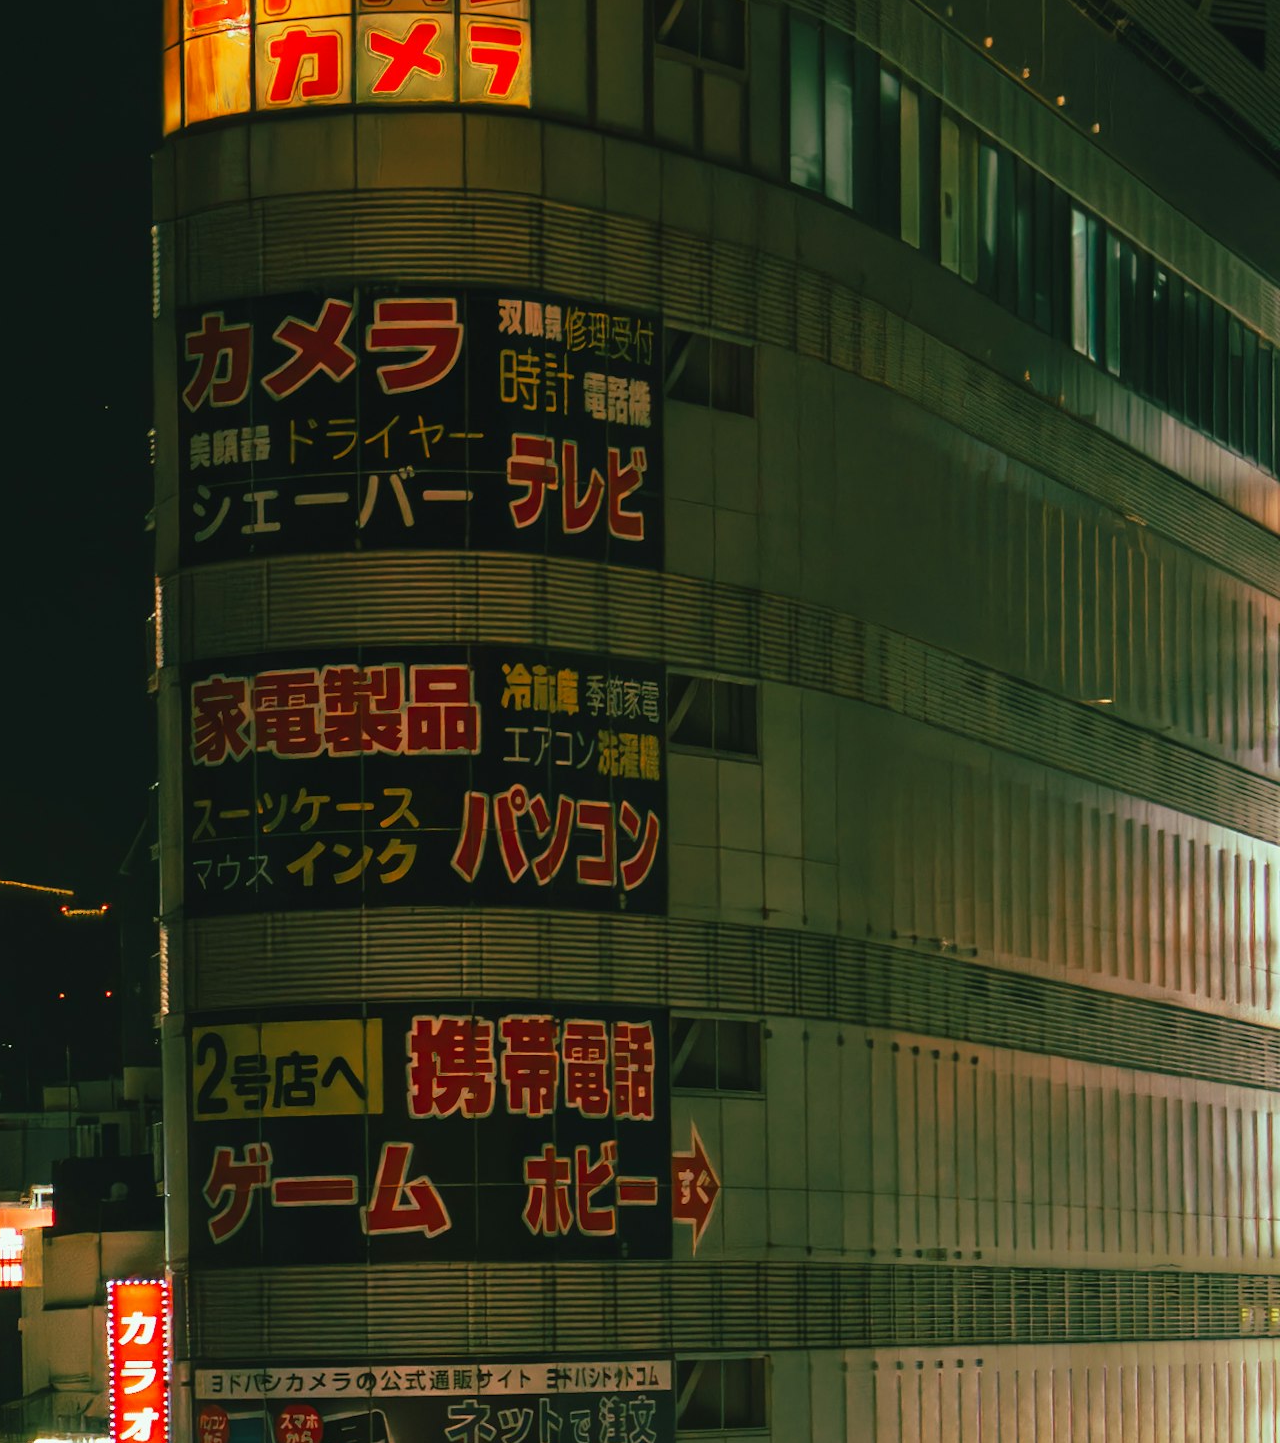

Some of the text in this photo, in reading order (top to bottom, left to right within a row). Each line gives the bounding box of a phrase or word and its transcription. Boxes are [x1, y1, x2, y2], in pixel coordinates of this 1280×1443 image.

[267, 19, 523, 104] カメラ
[183, 297, 464, 412] カメラ
[500, 348, 651, 428] 時計 電話機
[289, 414, 484, 464] ドライヤー
[507, 432, 647, 541] テレビ
[190, 662, 481, 767] 家電製品
[585, 674, 660, 724] 季節家電
[503, 726, 595, 770] エアコン
[191, 787, 420, 842] スーツケース
[450, 783, 660, 891] パソコン
[192, 838, 417, 892] マウス インク
[196, 1032, 367, 1116] 2号店へ
[405, 1014, 654, 1122] 携帯電話
[203, 1140, 658, 1245] ゲーム ホビー
[280, 1413, 319, 1429] スマホ
